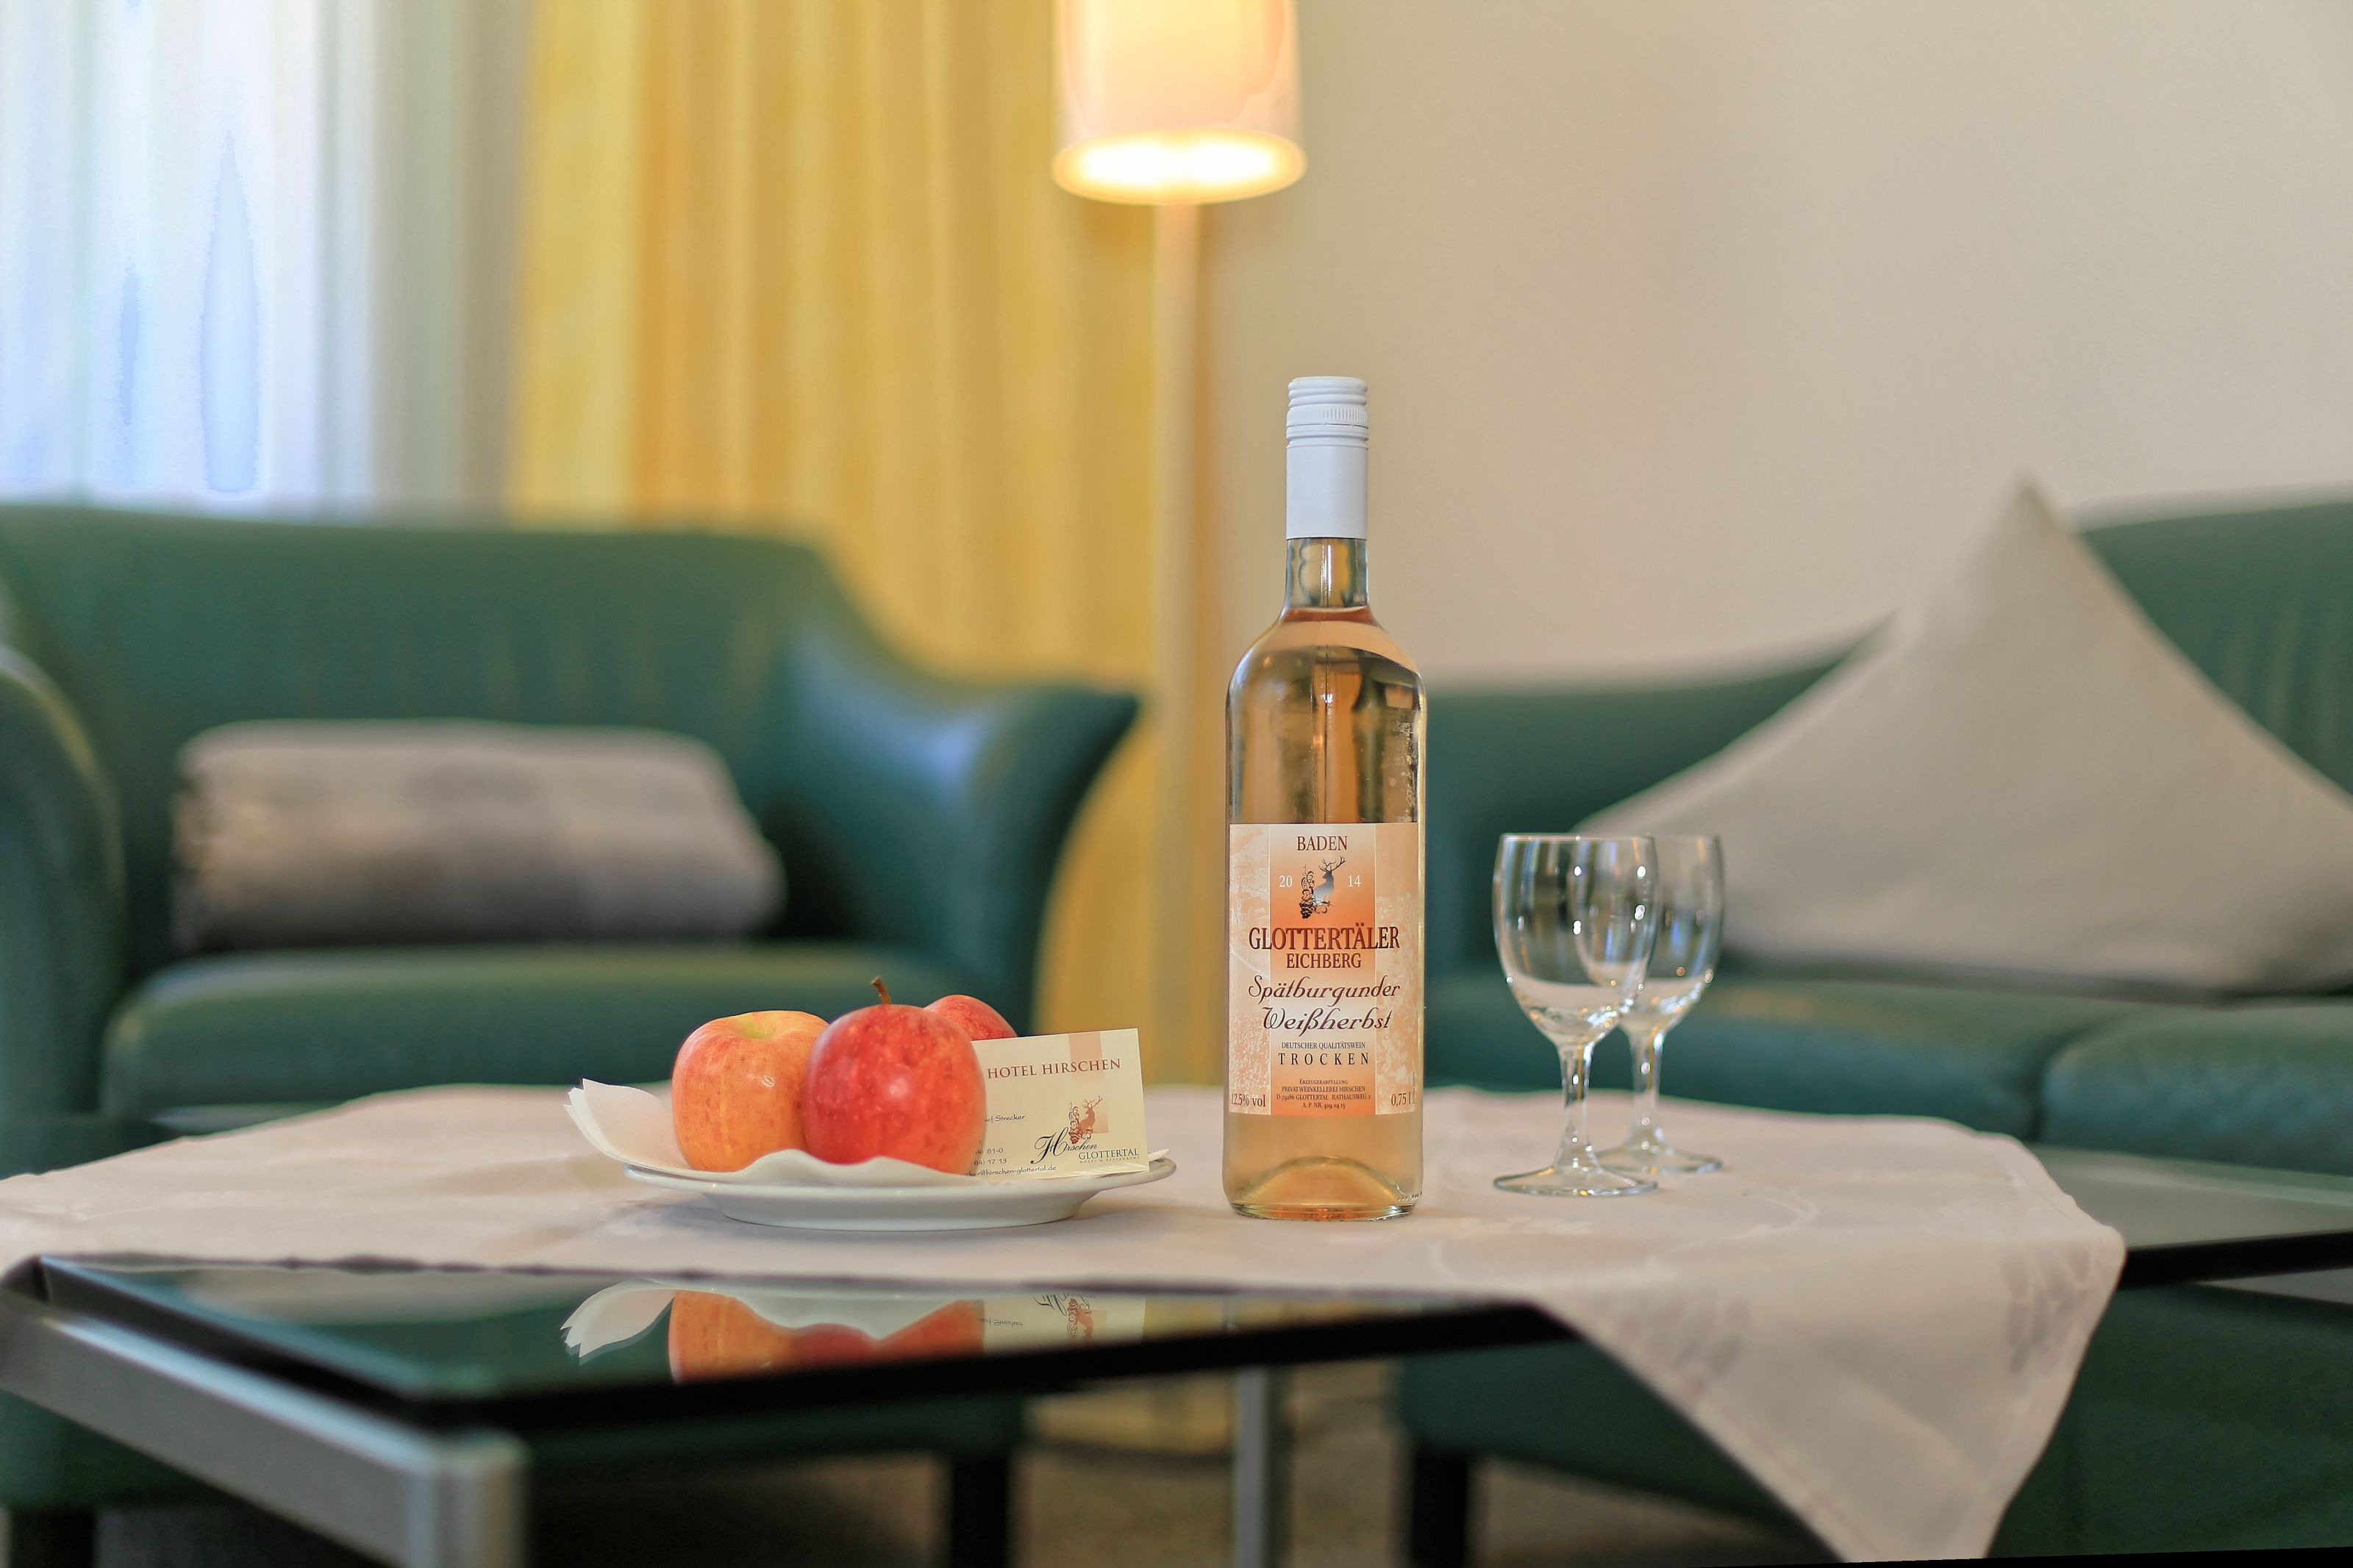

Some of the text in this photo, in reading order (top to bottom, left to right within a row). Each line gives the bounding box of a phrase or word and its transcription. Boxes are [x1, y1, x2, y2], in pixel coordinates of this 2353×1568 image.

[1296, 836, 1348, 851] BADEN
[1279, 875, 1361, 888] 20 14
[1249, 922, 1400, 950] GLOTTERTÄLER
[1286, 953, 1362, 969] EICHBERG
[1248, 975, 1401, 1008] Spätburgunder
[1262, 1006, 1393, 1037] Weißherbst
[1318, 1041, 1365, 1050] QUALITÄTSWEIN
[1278, 1053, 1369, 1065] TROCKEN
[987, 1059, 1121, 1079] HOTEL HIRSCHEN
[1252, 1094, 1265, 1107] vol
[1391, 1092, 1407, 1107] 0,75
[995, 1114, 1025, 1122] Strecker
[1078, 1148, 1140, 1160] GLOTTERTAL
